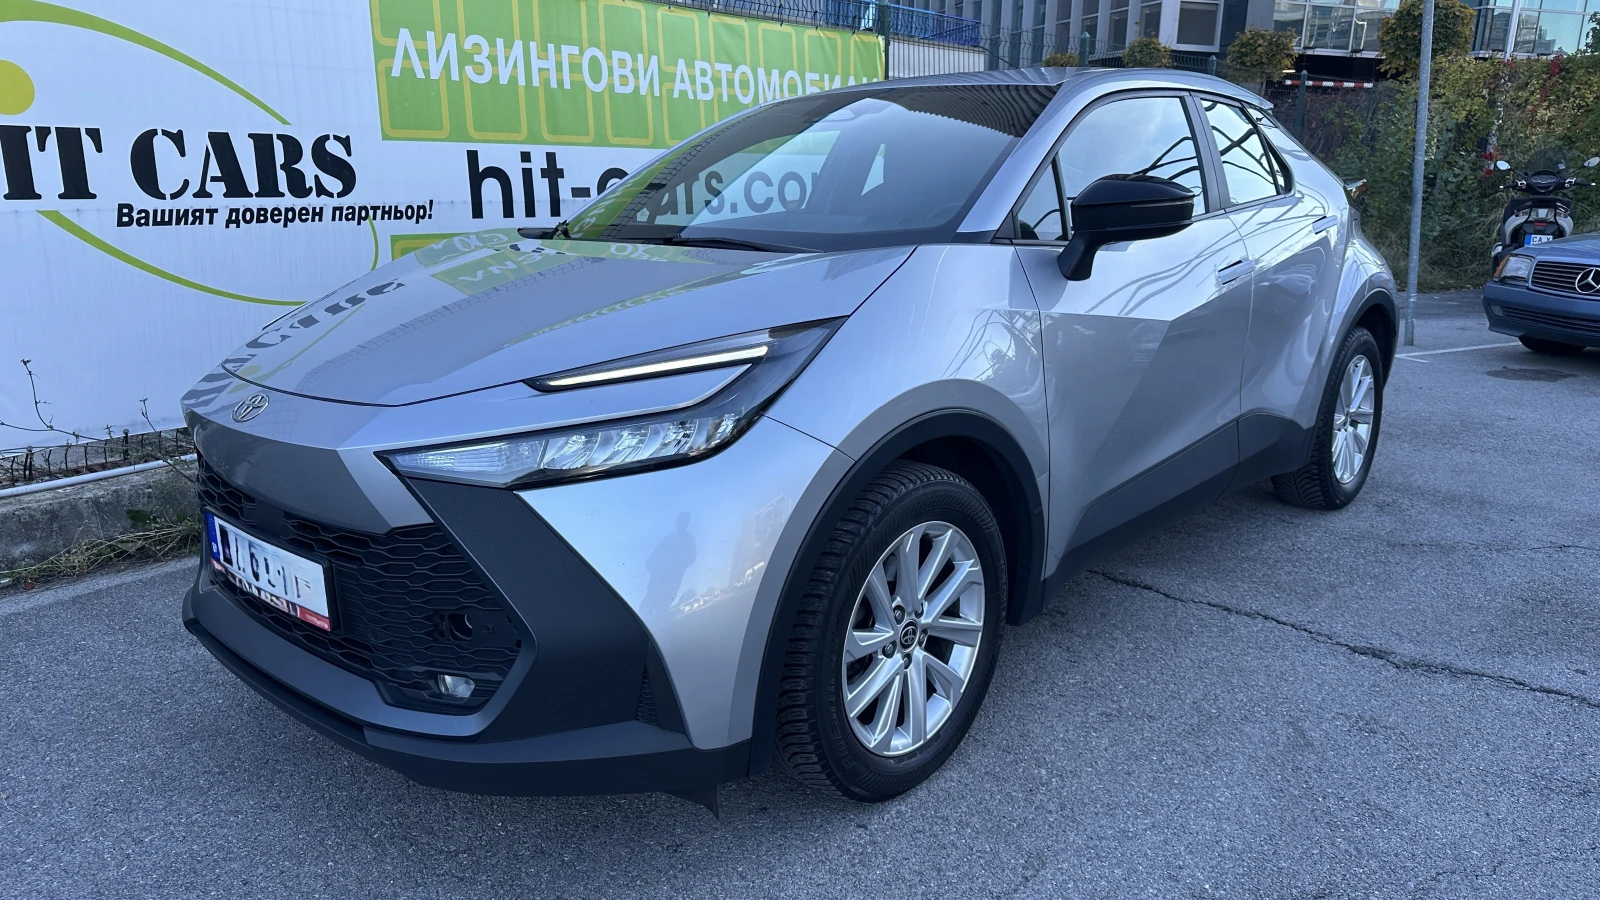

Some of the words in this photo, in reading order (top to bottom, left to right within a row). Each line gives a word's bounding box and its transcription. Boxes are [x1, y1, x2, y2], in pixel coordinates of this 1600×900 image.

[391, 28, 660, 96] ЛИЗИНГОВИ
[130, 128, 357, 200] CARS
[116, 202, 219, 227] Вашият
[225, 205, 323, 229] доверен
[331, 200, 434, 224] партньор!
